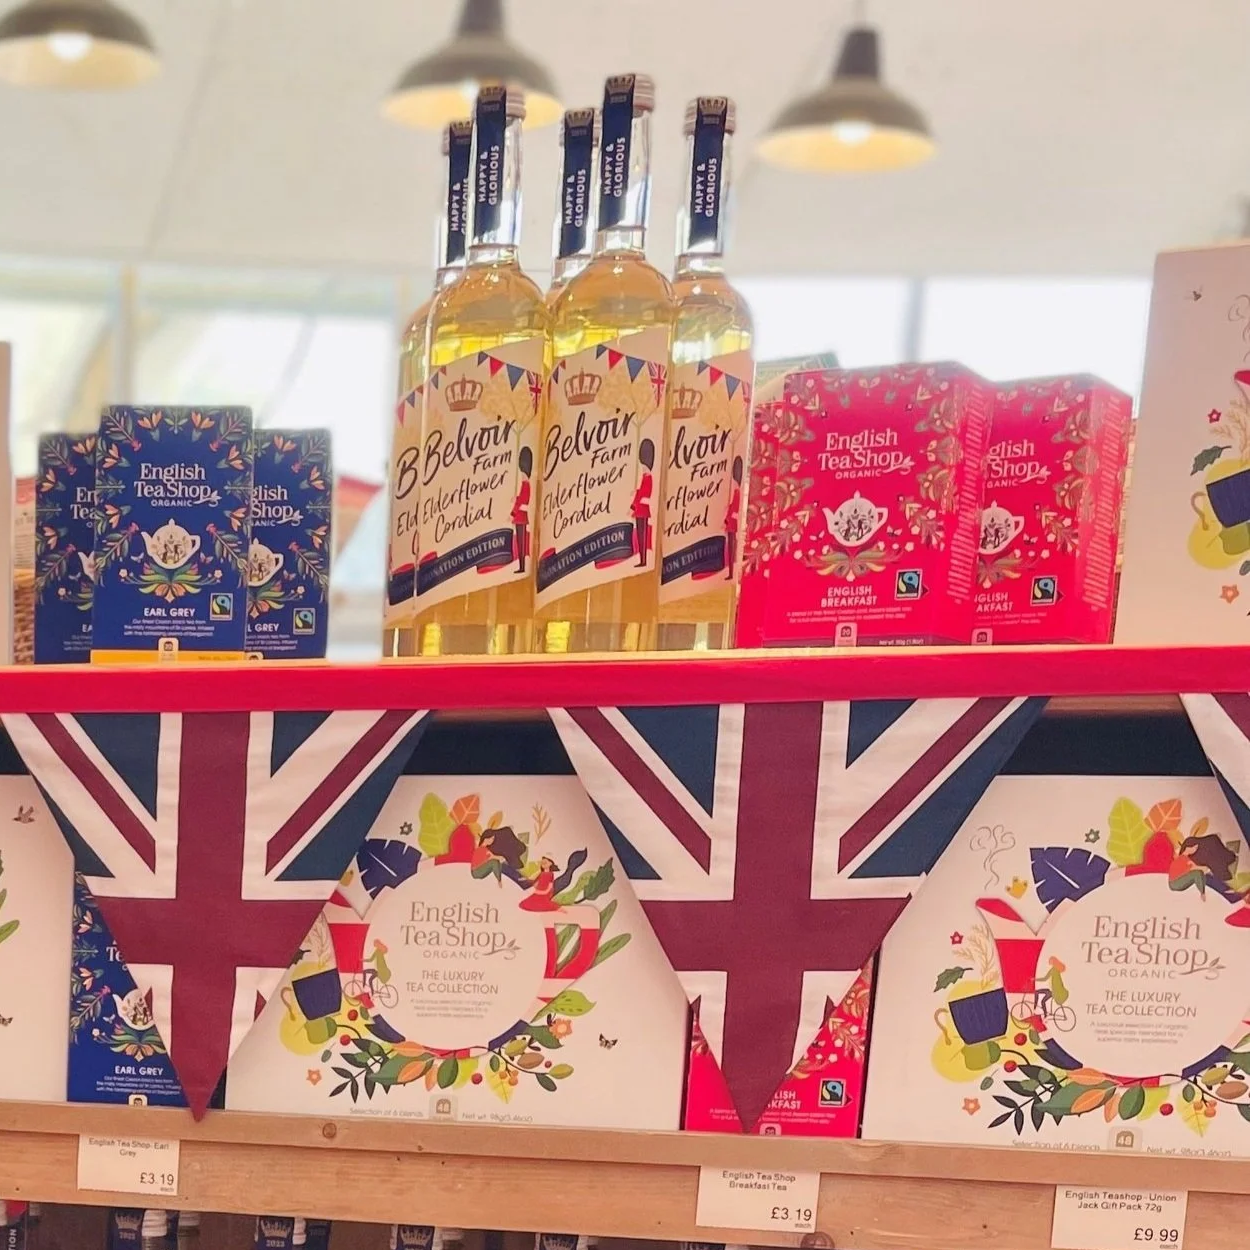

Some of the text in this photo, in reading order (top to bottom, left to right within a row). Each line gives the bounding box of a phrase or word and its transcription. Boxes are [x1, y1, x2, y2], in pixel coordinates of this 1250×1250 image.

[489, 145, 499, 205] GLORIOUS
[604, 157, 613, 194] HAPPY
[614, 137, 625, 197] GLORIOUS
[478, 164, 488, 202] HAPPY
[706, 158, 717, 217] GLORIOUS
[575, 169, 586, 228] GLORIOUS
[695, 176, 704, 213] HAPPY
[565, 188, 574, 224] HAPPY
[422, 415, 517, 486] Belvoir
[543, 408, 636, 482] Belvoir
[825, 429, 898, 452] English
[473, 450, 512, 473] Farm
[591, 442, 631, 468] Farm
[140, 462, 206, 484] English
[434, 498, 493, 543] Cordial
[553, 493, 611, 539] Cordial
[821, 596, 877, 607] BREAKFAST
[827, 587, 872, 597] ENGLISH
[144, 607, 196, 618] EARL GREY
[410, 901, 499, 928] English
[1094, 916, 1201, 946] English
[423, 951, 479, 960] ORGANIC
[422, 970, 485, 981] THE LUXURY
[1108, 968, 1177, 979] ORGANIC
[406, 982, 499, 995] TEA COLLECTION
[1105, 991, 1181, 1002] THE LUXURY
[1086, 1004, 1197, 1018] TEA COLLECTION
[115, 1066, 164, 1076] EARL GREY
[140, 1172, 174, 1185] £3.19
[722, 1171, 796, 1183] English Tea Shop
[771, 1183, 787, 1191] Tea
[1065, 1191, 1177, 1202] English Teashop Union
[1145, 1203, 1162, 1212] 72g
[771, 1206, 811, 1221] £3.19
[1134, 1227, 1178, 1242] £9.99
